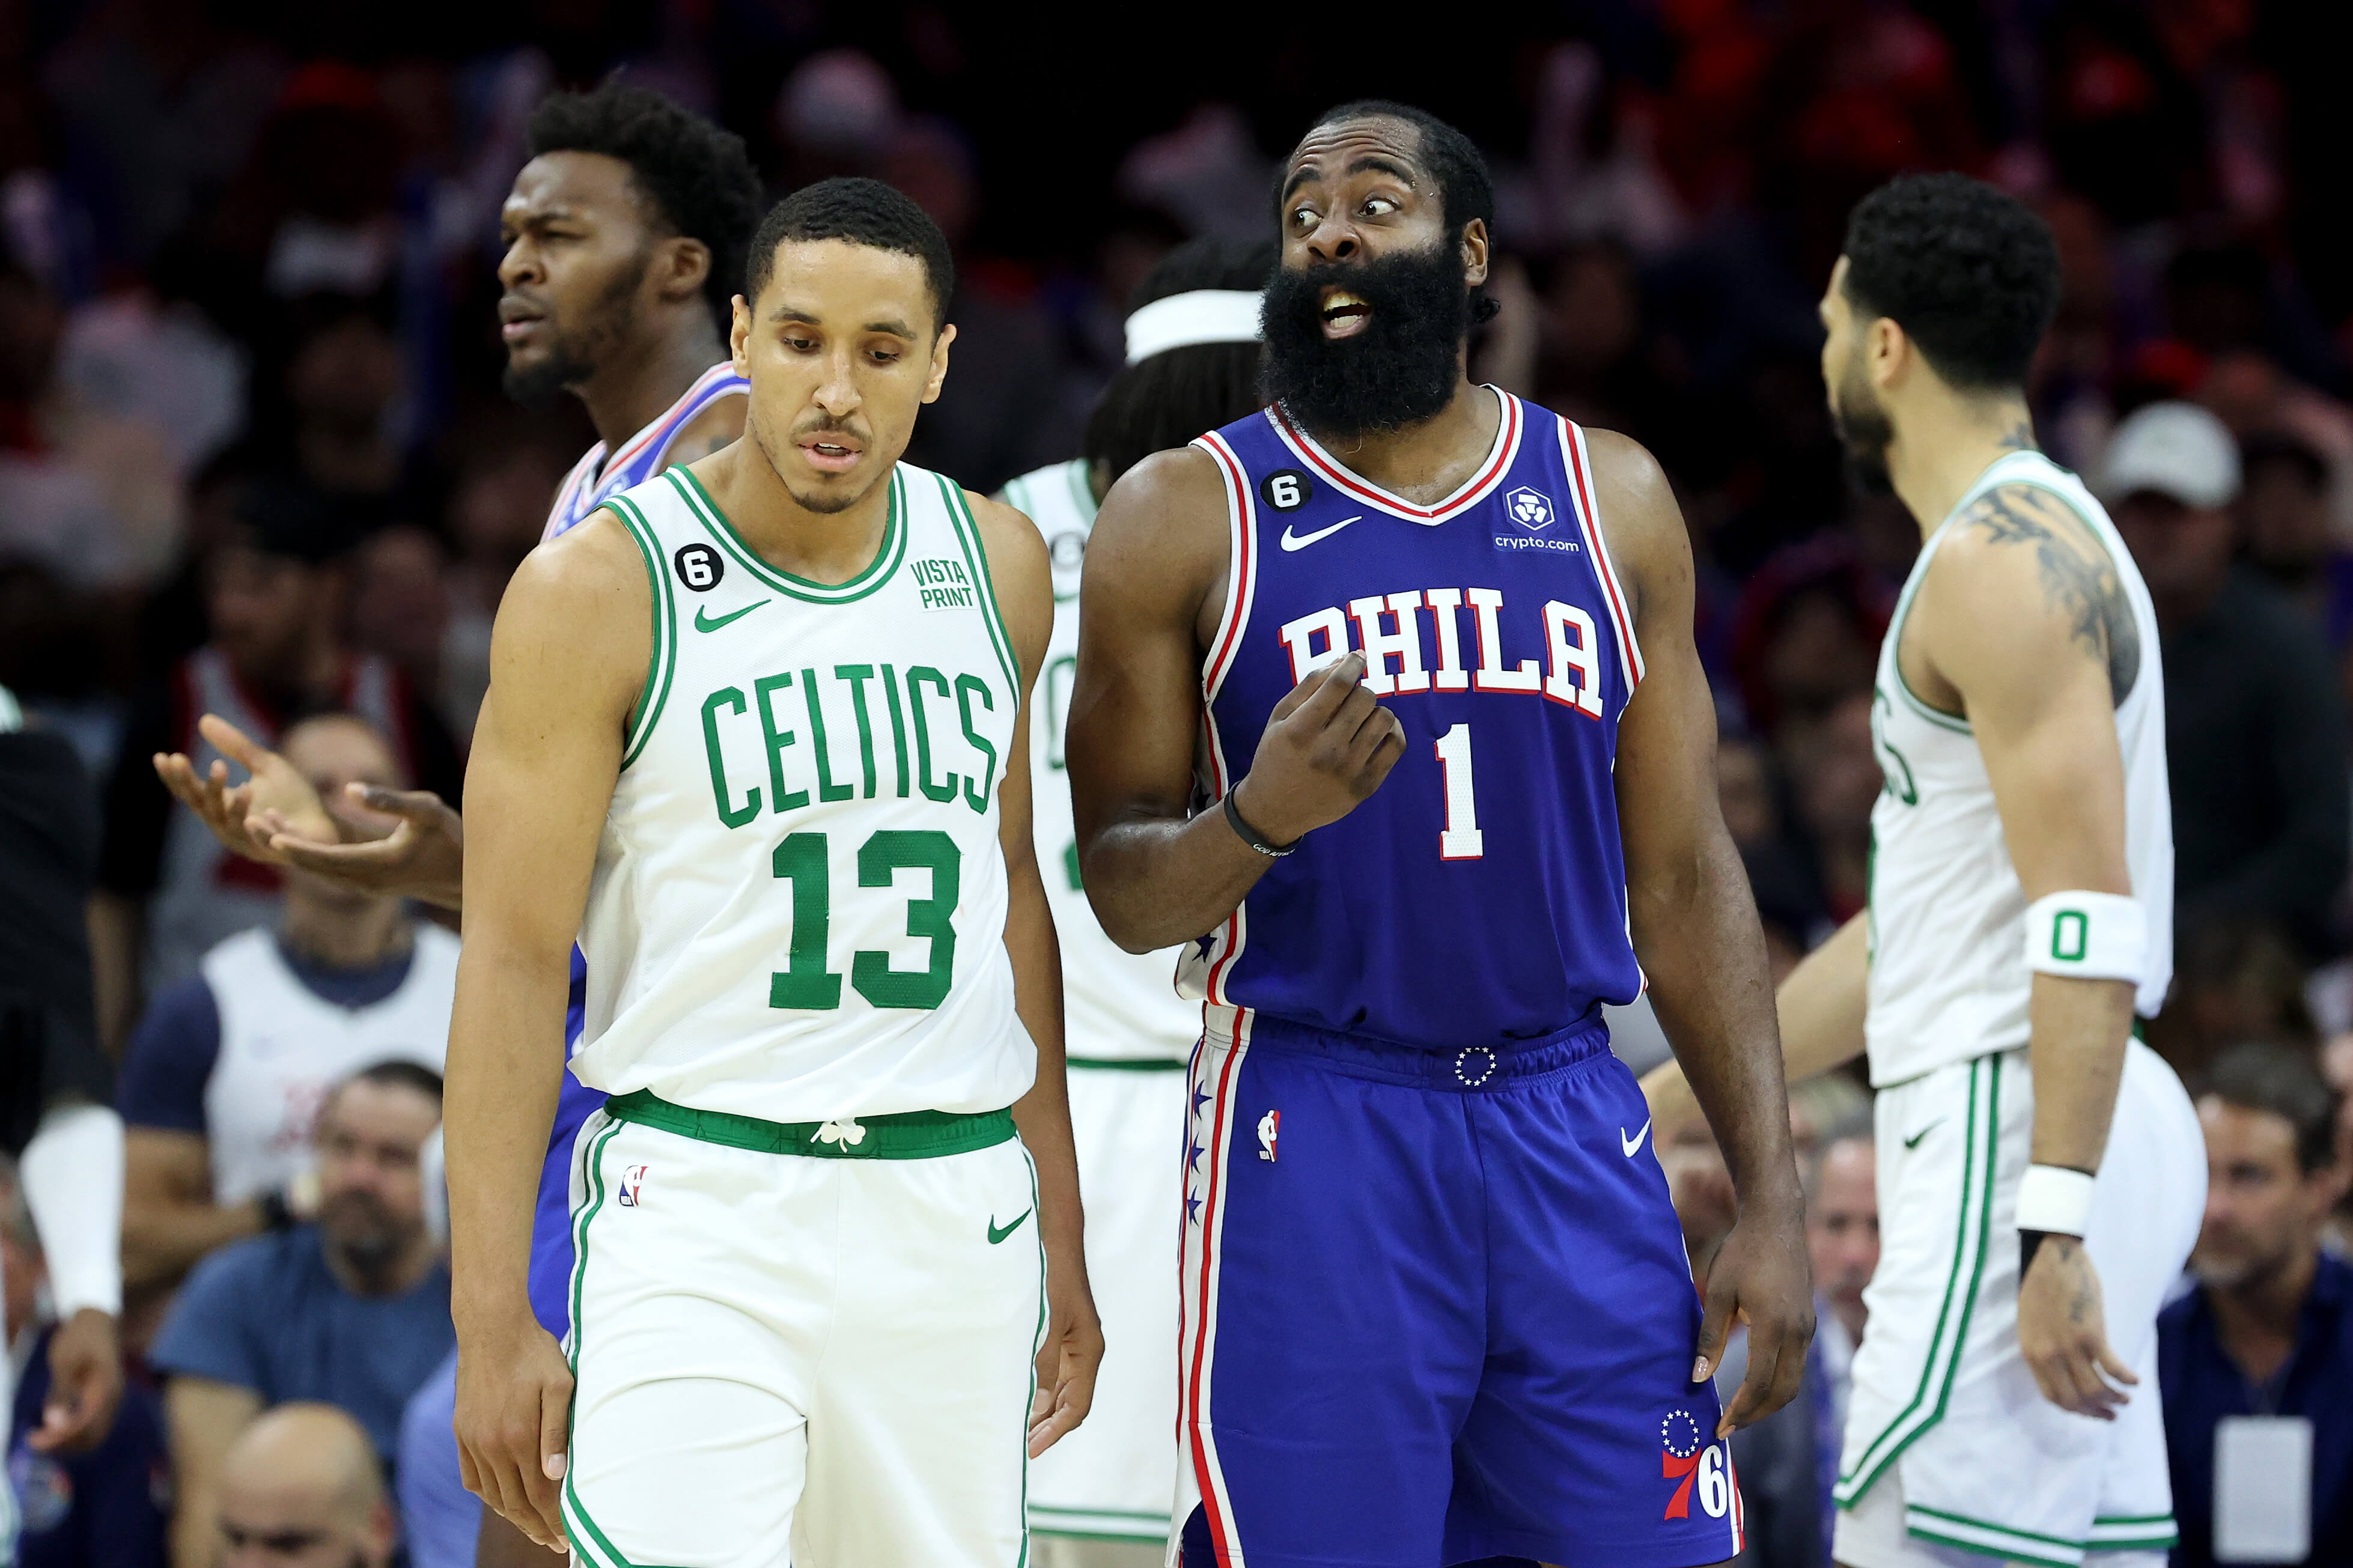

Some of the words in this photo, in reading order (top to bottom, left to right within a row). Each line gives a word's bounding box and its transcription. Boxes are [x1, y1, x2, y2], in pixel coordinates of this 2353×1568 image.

[1271, 475, 1301, 508] 6
[682, 550, 713, 586] 6
[1494, 536, 1580, 552] crypto.com
[910, 559, 969, 587] VISTA
[919, 587, 973, 609] PRINT
[1277, 587, 1604, 721] PHILA
[701, 663, 997, 829] CELTICS
[1434, 723, 1484, 860] 1
[769, 830, 961, 1010] 13
[2051, 910, 2088, 961] 0
[1661, 1444, 1728, 1521] 76
